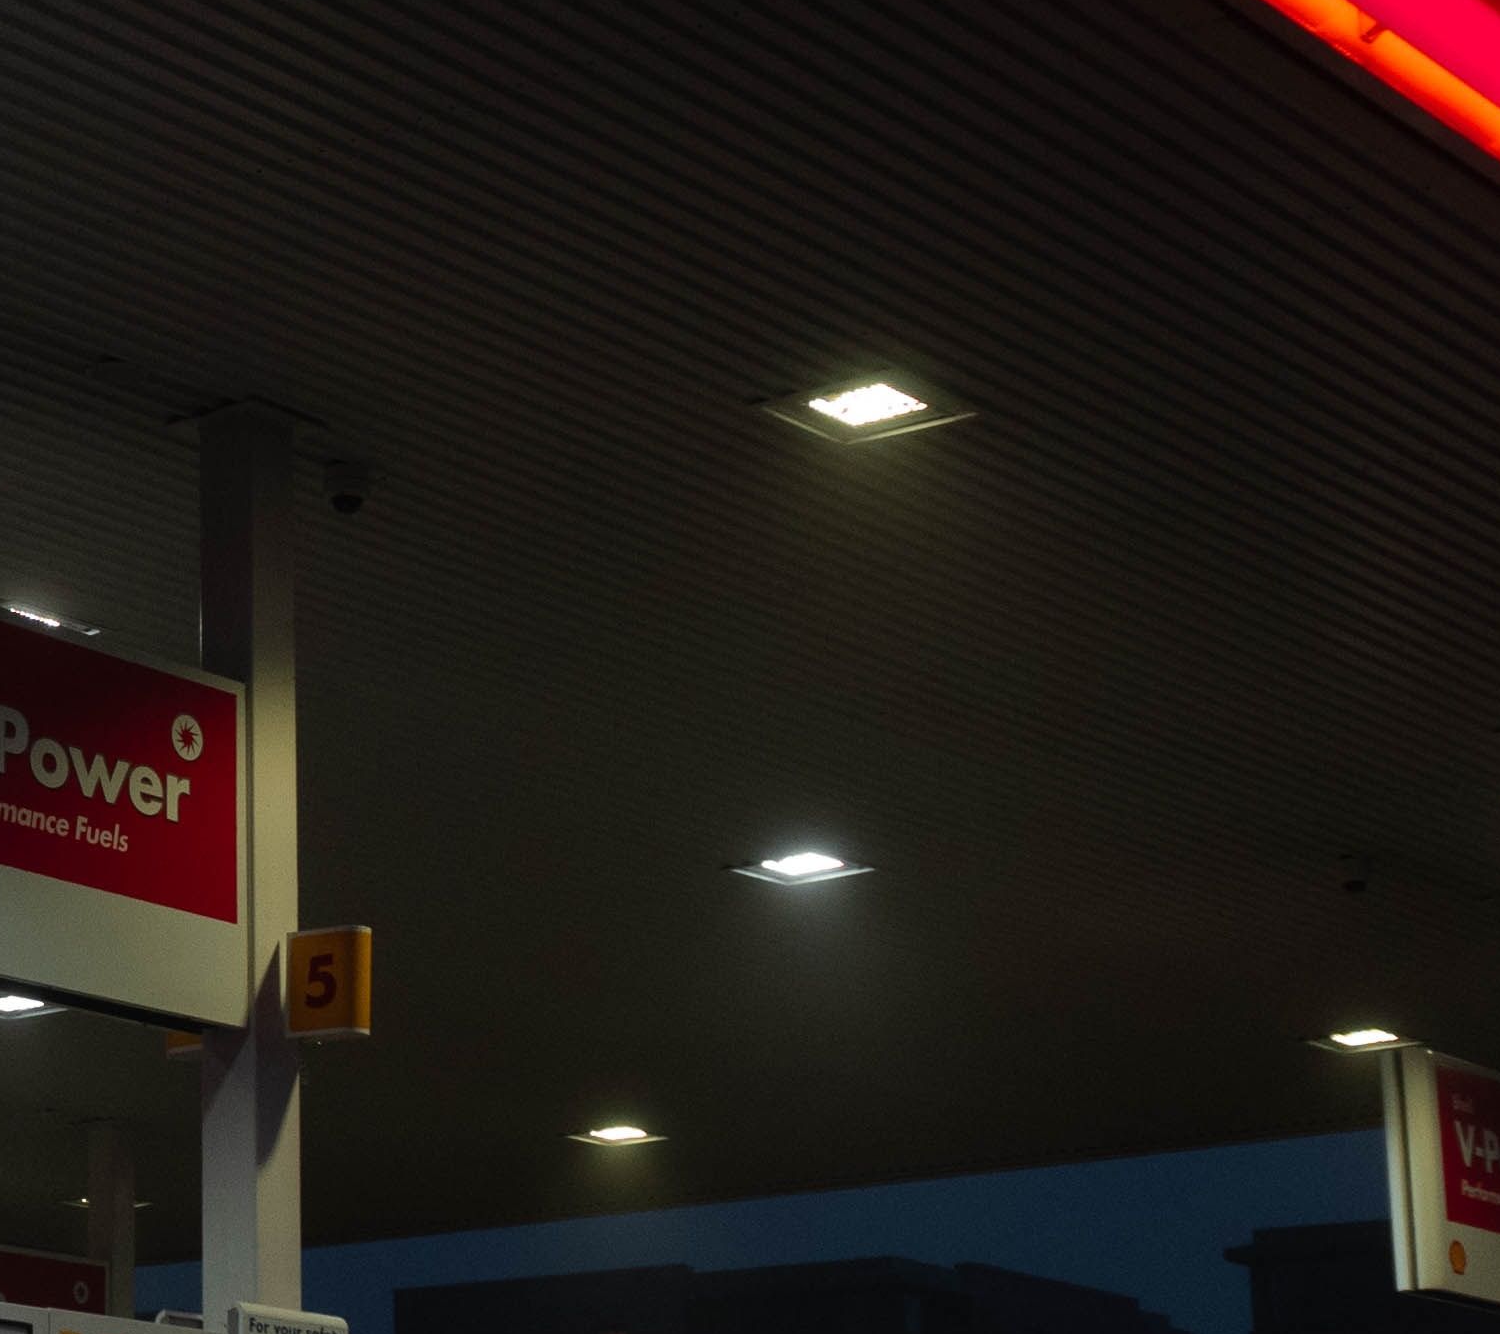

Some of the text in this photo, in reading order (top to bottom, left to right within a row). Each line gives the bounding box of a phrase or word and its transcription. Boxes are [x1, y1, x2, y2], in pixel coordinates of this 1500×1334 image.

[74, 816, 129, 853] Fuels
[304, 953, 337, 1009] 5
[250, 1318, 268, 1334] For
